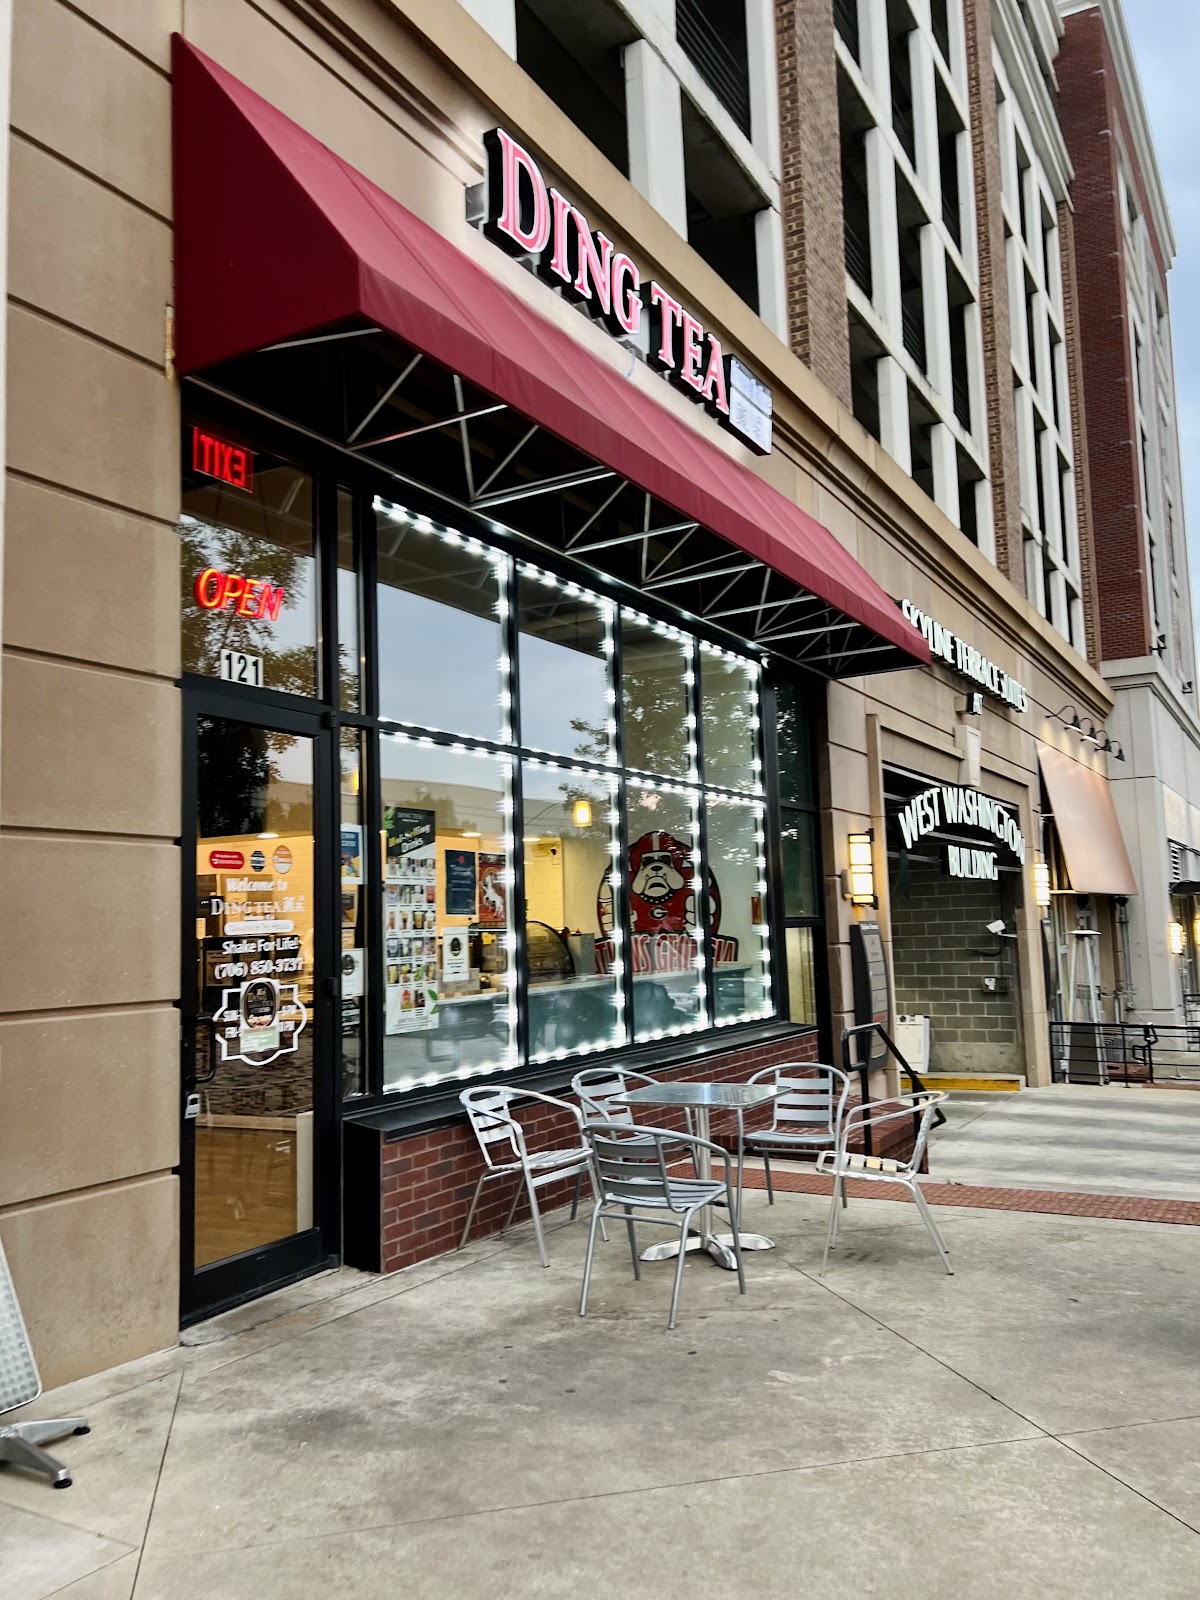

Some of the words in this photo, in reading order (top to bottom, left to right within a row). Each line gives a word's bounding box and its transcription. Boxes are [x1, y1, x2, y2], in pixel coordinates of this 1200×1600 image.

[497, 127, 643, 335] DING
[651, 280, 730, 415] TEA
[195, 568, 284, 621] OPEN
[901, 598, 955, 664] SKYLINE
[953, 636, 1001, 695] TERRACE
[224, 651, 262, 686] 121
[898, 787, 940, 849] WEST
[942, 786, 1026, 865] WASHINGTON
[947, 844, 999, 881] BUILDING
[225, 877, 275, 892] Welcome
[277, 878, 288, 891] to
[210, 898, 253, 915] DING
[254, 900, 283, 913] TEA
[222, 938, 257, 955] Shake
[258, 938, 276, 952] For
[214, 961, 249, 979] (706)
